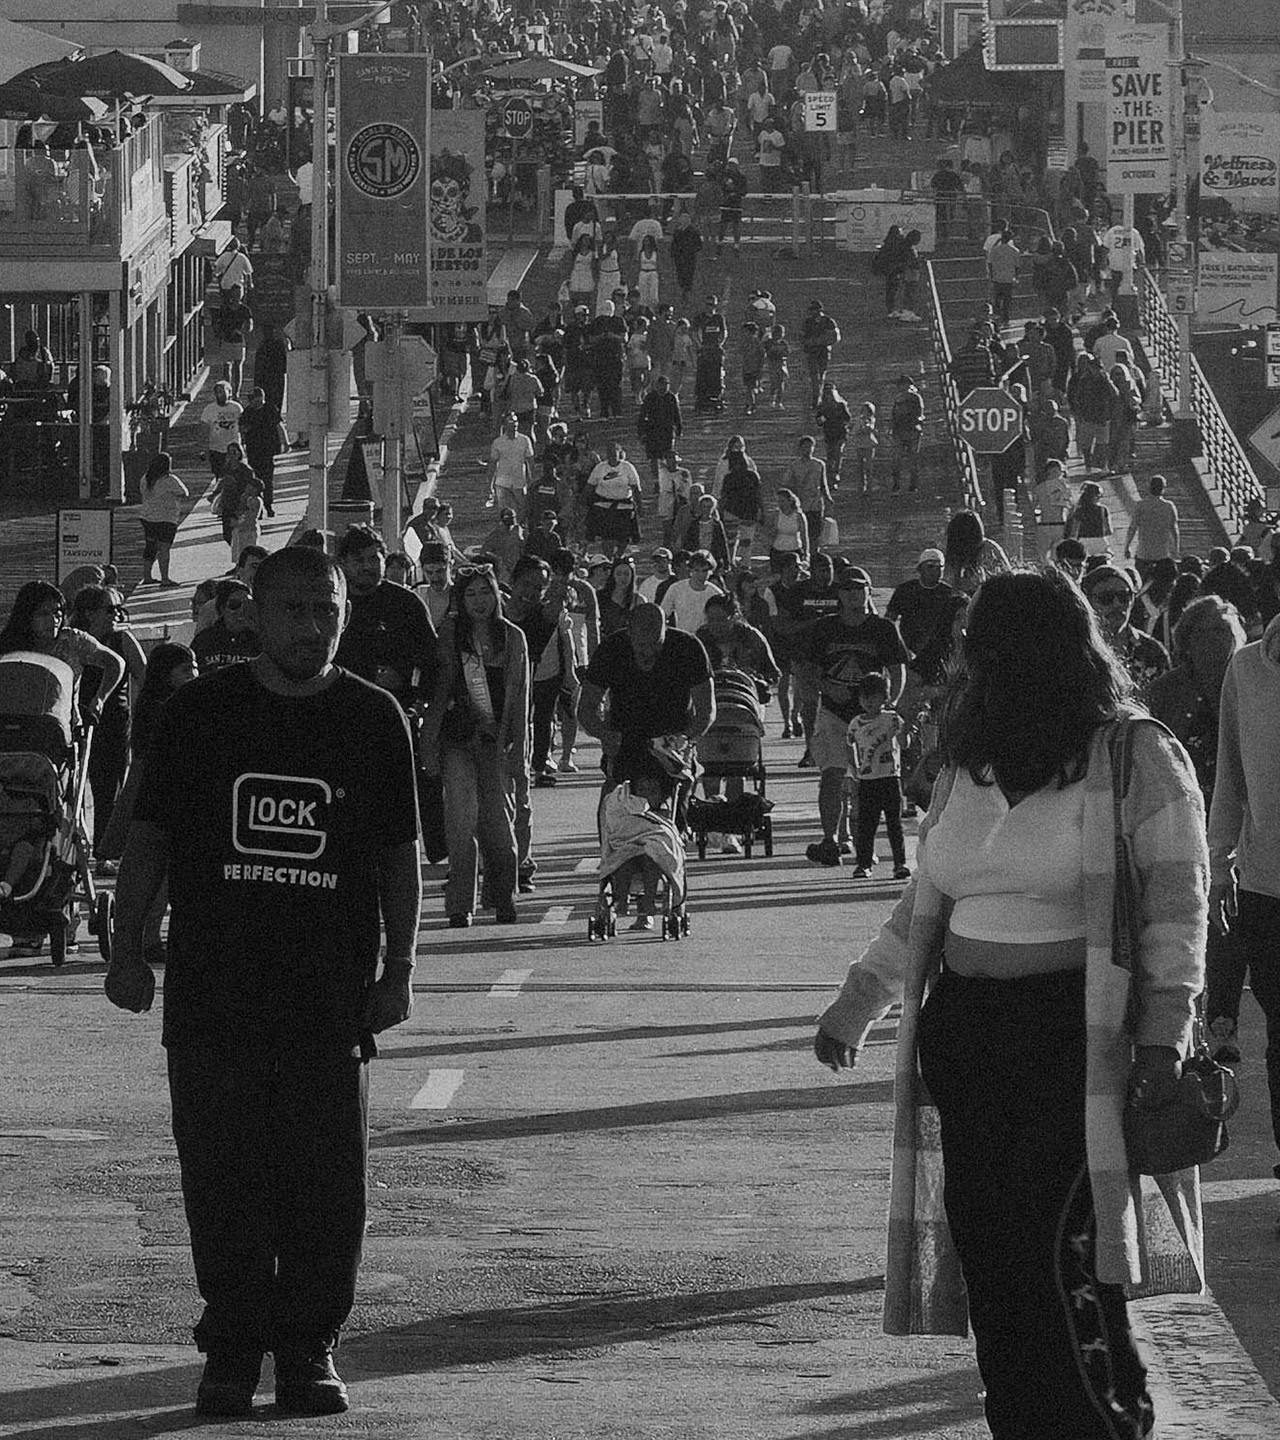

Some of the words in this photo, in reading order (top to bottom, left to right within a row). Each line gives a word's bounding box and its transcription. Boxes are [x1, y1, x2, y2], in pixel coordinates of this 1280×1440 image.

[1112, 73, 1162, 98] SAVE
[1123, 101, 1153, 117] THE
[505, 111, 531, 125] STOP
[816, 112, 826, 126] 5
[1113, 120, 1163, 145] PIER
[1204, 154, 1276, 170] Wellness
[1224, 171, 1276, 186] Waves
[346, 253, 379, 264] SEPT.
[394, 253, 420, 264] MAY
[432, 296, 480, 305] VEMBER
[1176, 296, 1186, 310] 5
[1272, 343, 1280, 351] 15
[961, 408, 1018, 432] STOP
[224, 864, 338, 889] PERFECTION
